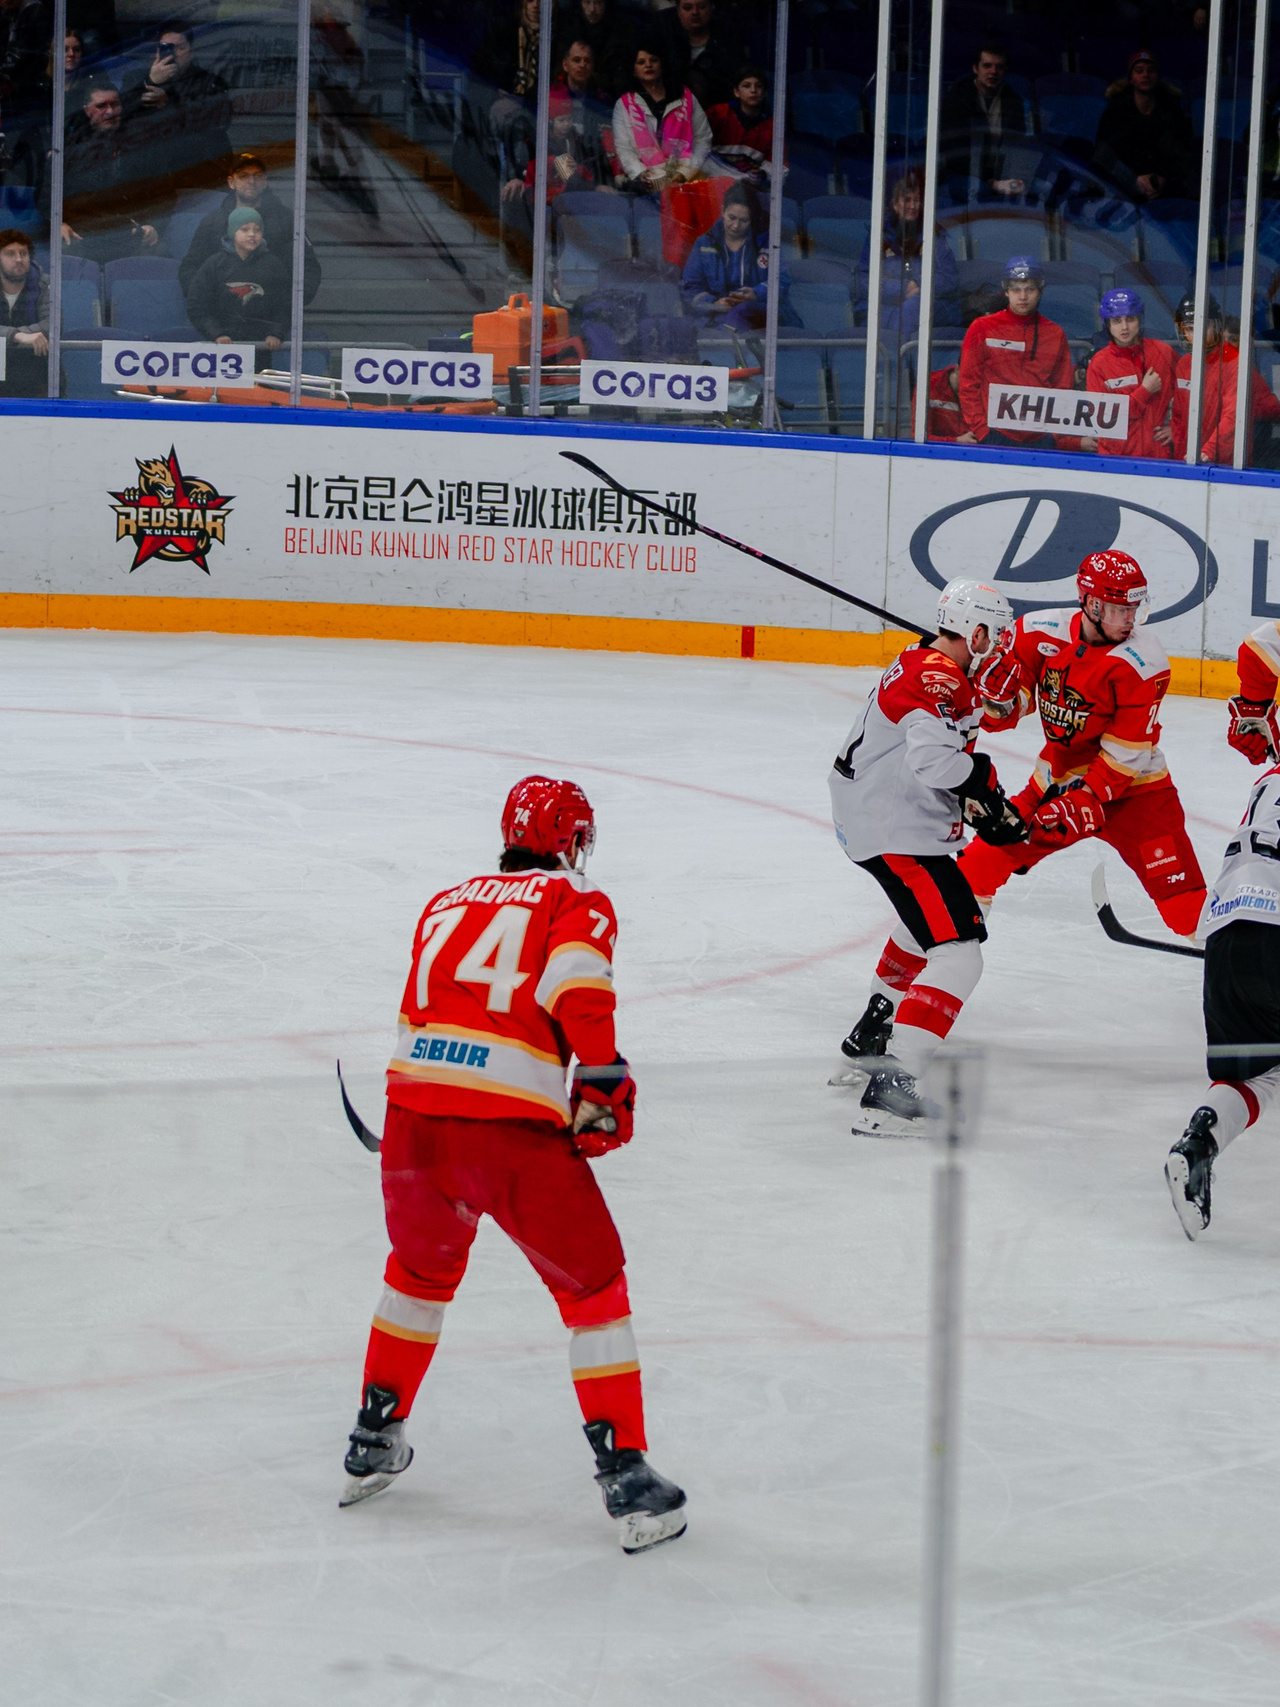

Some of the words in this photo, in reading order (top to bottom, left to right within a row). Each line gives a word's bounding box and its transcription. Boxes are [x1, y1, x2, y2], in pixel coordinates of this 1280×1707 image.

[996, 392, 1120, 429] KHL.RU
[285, 473, 698, 536] 北京昆仑鸿星冰球俱乐部
[109, 505, 234, 546] REDSTAR
[284, 527, 362, 556] BEIJING
[371, 531, 449, 560] KUNLUN
[458, 534, 496, 562] RED
[504, 536, 553, 565] STAR
[561, 539, 639, 569] HOCKEY
[647, 544, 697, 573] CLUB
[1121, 563, 1137, 574] 24
[1040, 699, 1090, 733] EDSTAR
[514, 807, 530, 826] 74
[415, 904, 532, 1014] 74
